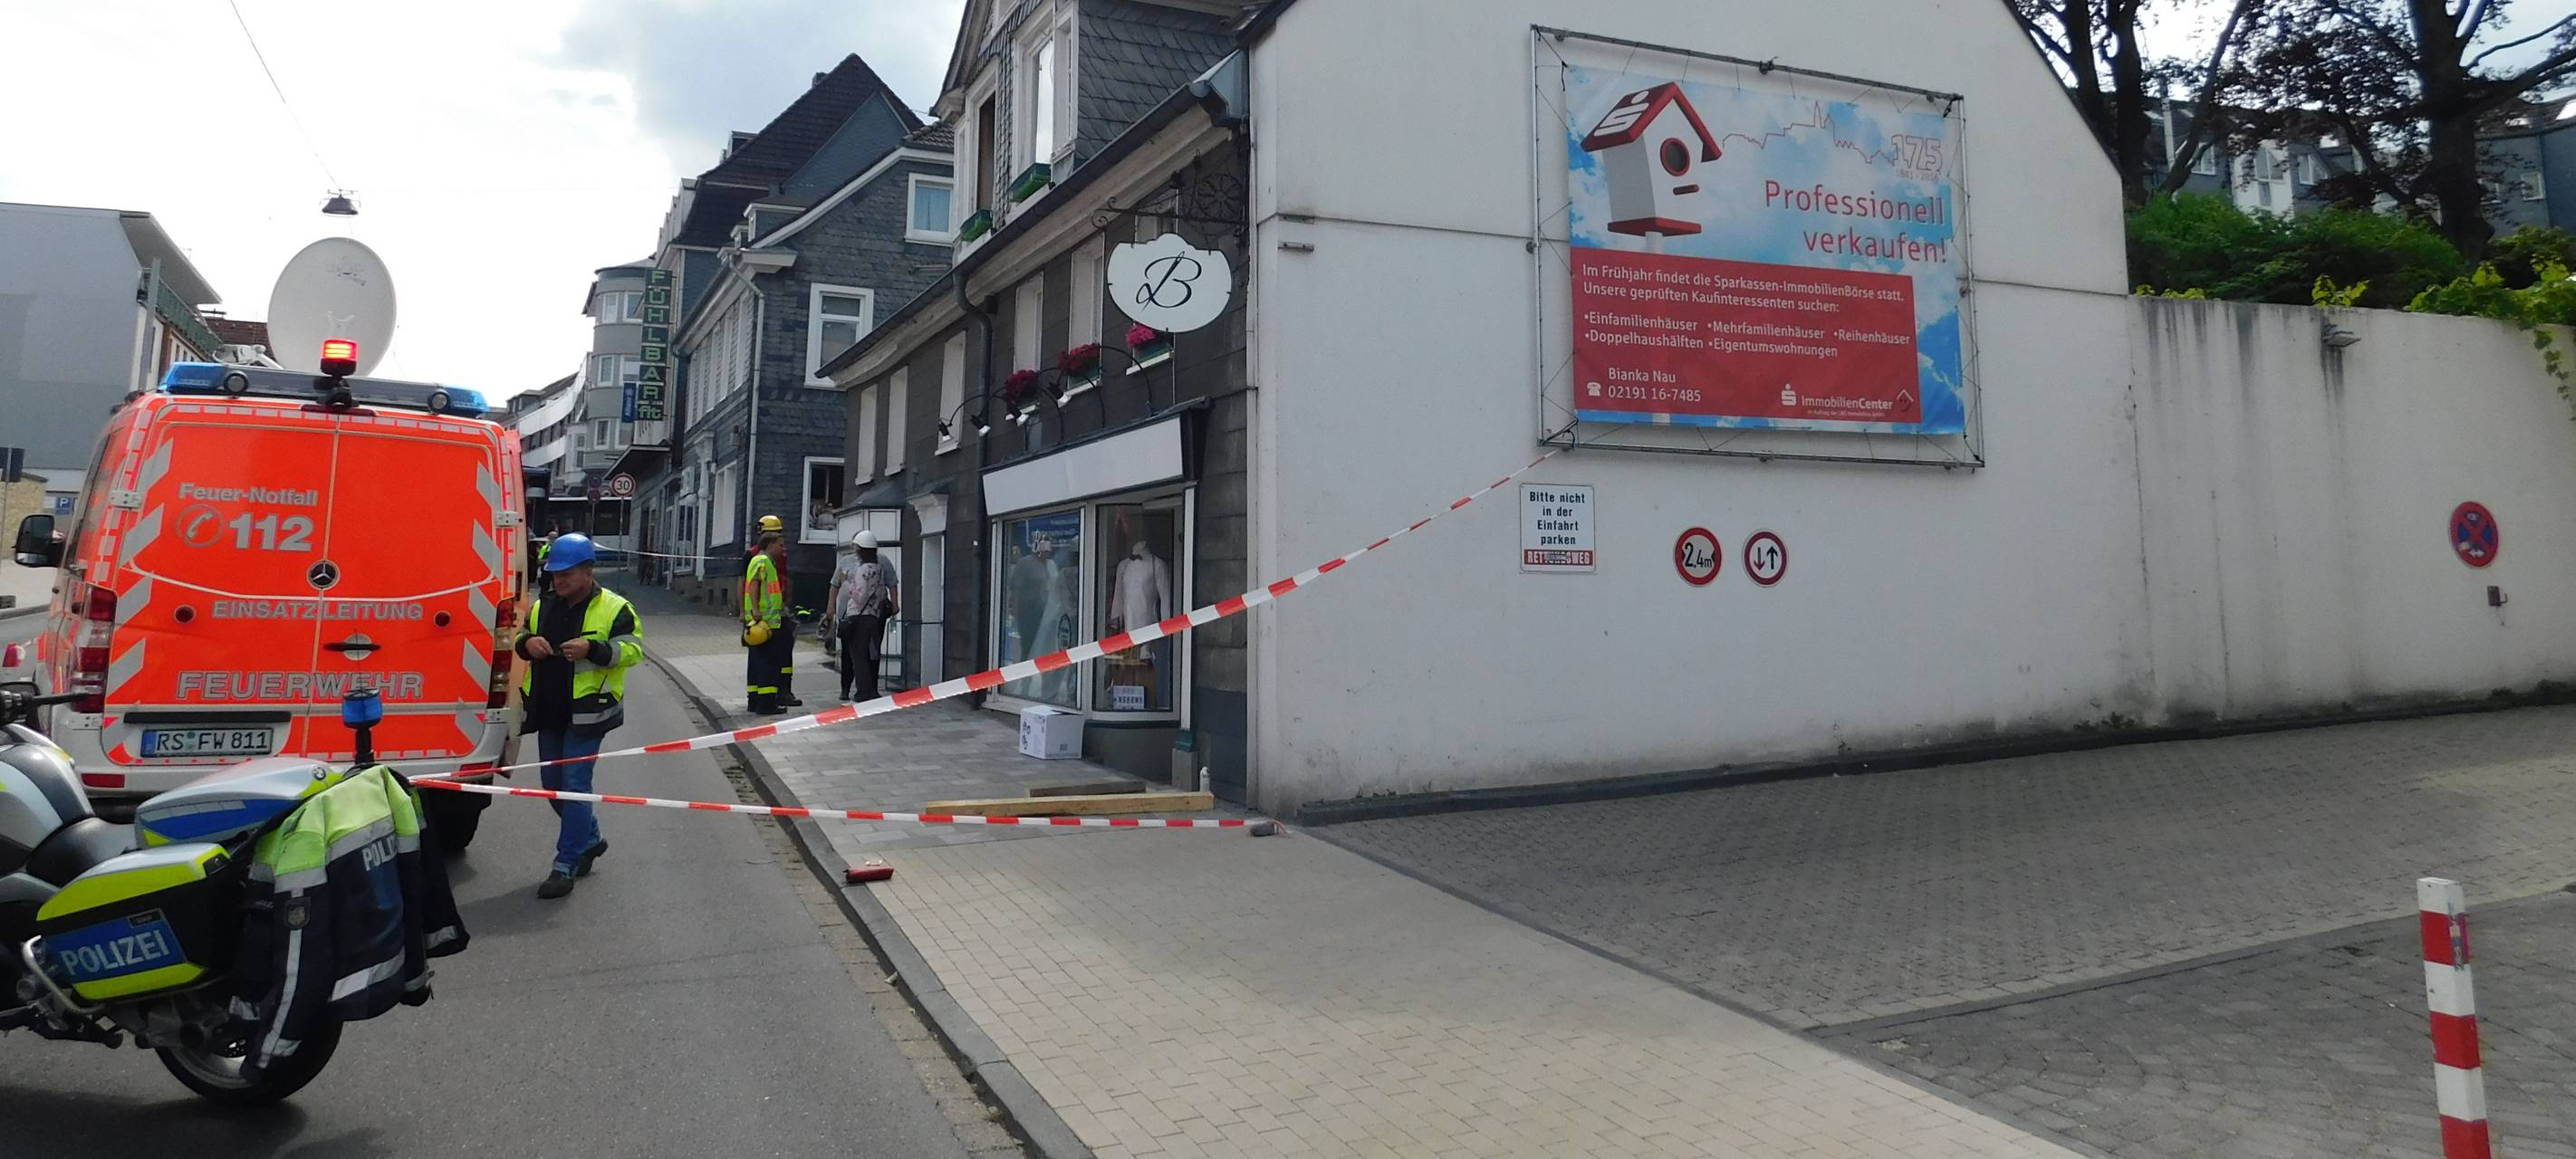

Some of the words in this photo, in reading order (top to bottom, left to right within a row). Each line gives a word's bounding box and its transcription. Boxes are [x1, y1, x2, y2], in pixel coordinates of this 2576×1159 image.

[1891, 134, 1943, 172] 175
[1765, 179, 1944, 225] Professionell
[1803, 226, 1946, 263] verkaufen!
[1136, 250, 1202, 312] B
[1582, 263, 1599, 276] Im
[1601, 265, 1653, 283] Frühjahr
[1656, 269, 1690, 284] findet
[1693, 273, 1711, 287] die
[1714, 274, 1875, 300] Sparkassen-ImmobilienBörse
[1877, 291, 1905, 302] statt.
[1583, 282, 1627, 296] Unsere
[1630, 286, 1688, 302] geprüften
[1691, 290, 1795, 311] Kaufinteressenten
[1797, 300, 1841, 312] suchen:
[1608, 367, 1649, 381] Bianka
[1652, 369, 1677, 383] Nau
[1608, 385, 1647, 399] 02191
[1651, 388, 1702, 402] 16-7485
[1801, 395, 1893, 410] ImmobilienCenter
[179, 483, 318, 507] Feuer-Notfall
[616, 480, 630, 490] 30
[60, 498, 69, 507] P
[1529, 491, 1555, 503] Bitte
[1560, 493, 1585, 503] nicht
[1543, 506, 1552, 516] in
[1556, 506, 1573, 517] der
[229, 512, 313, 551] 112
[1537, 520, 1579, 531] Einfahrt
[1541, 534, 1576, 546] parken
[211, 600, 424, 621] EINSATZLEITUNG
[176, 670, 426, 701] FEUERWEHR
[156, 733, 185, 751] RS
[197, 733, 226, 750] FW
[231, 732, 268, 749] 811
[59, 929, 170, 976] POLIZEI
